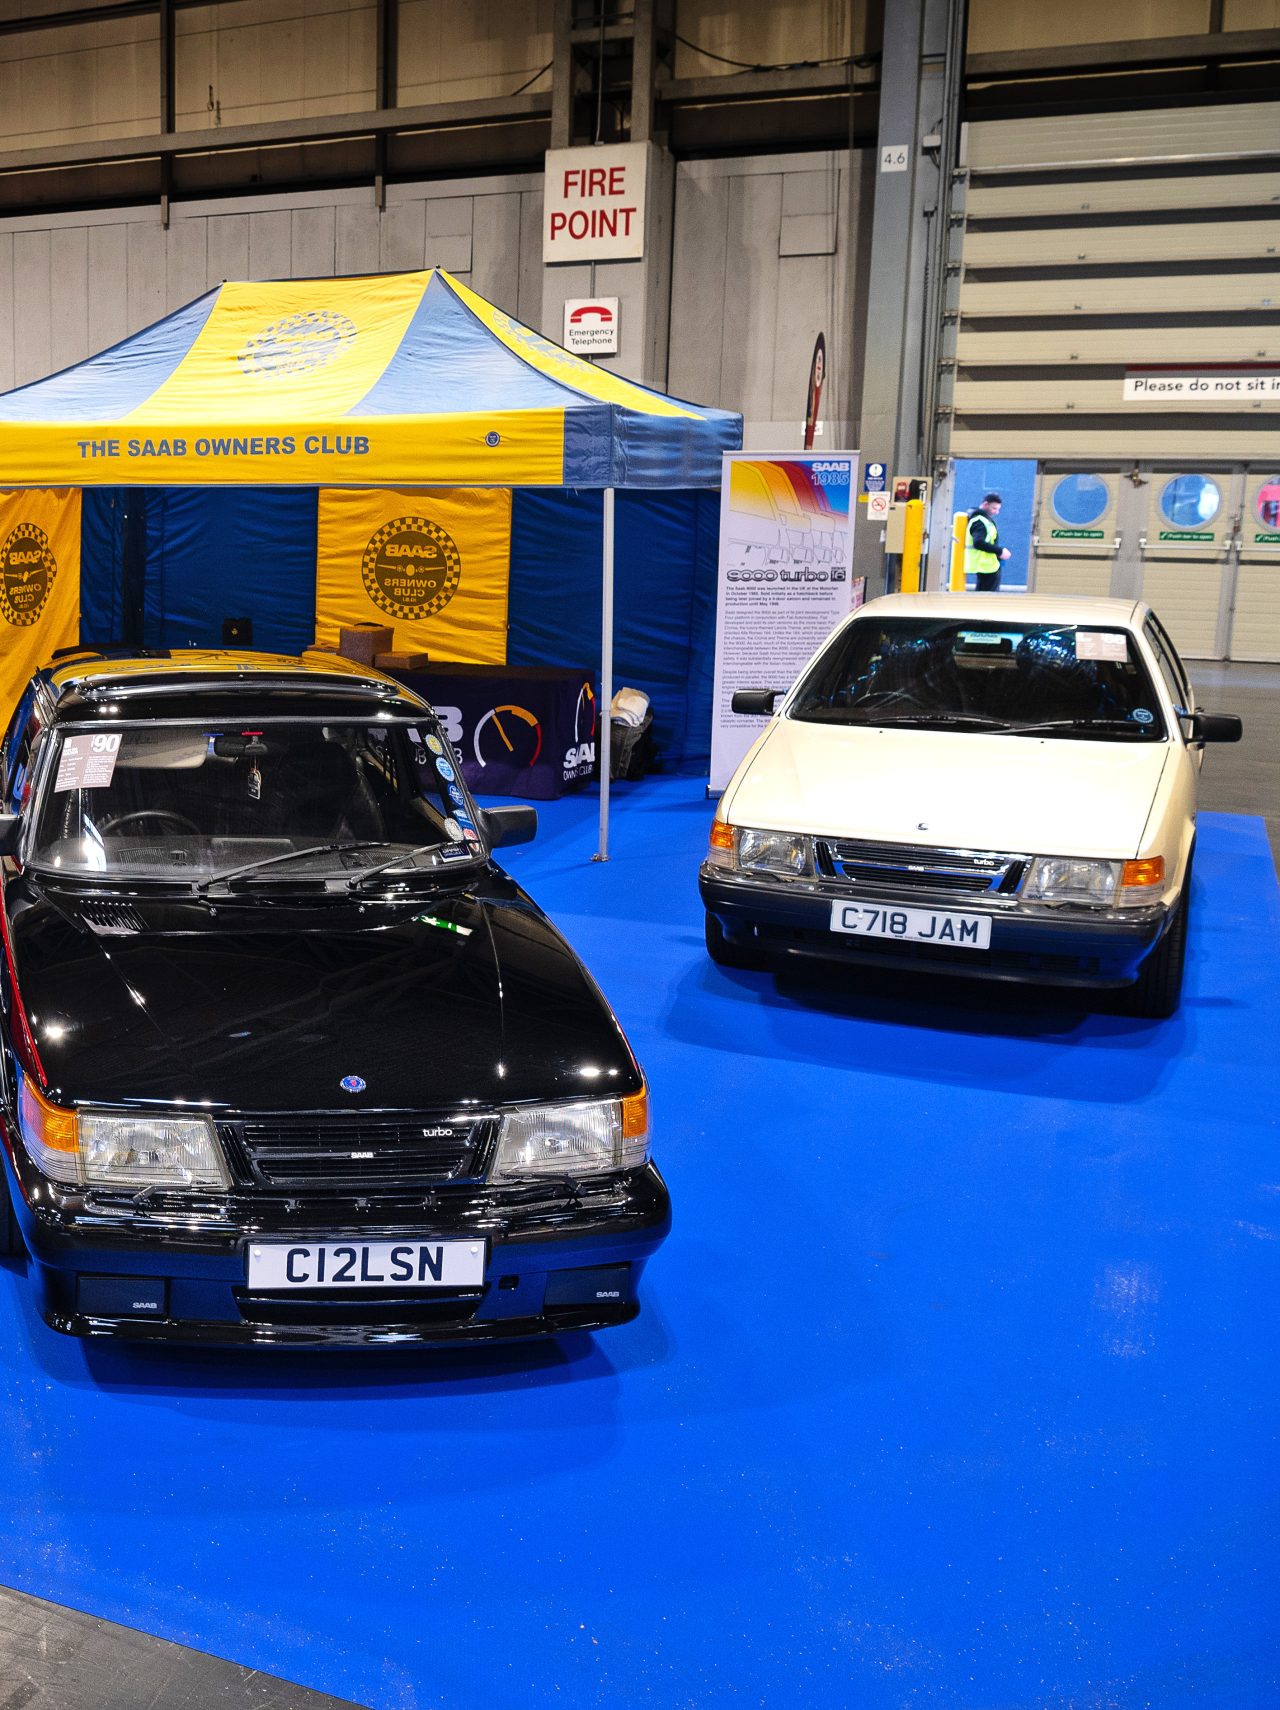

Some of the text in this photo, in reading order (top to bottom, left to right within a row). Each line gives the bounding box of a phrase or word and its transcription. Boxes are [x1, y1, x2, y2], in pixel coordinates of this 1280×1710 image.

[884, 153, 905, 164] 4.6
[563, 166, 625, 198] FIRE
[550, 207, 637, 240] POINT
[569, 328, 614, 337] Emergency
[571, 338, 612, 346] Telephone
[1134, 379, 1183, 392] Please
[1189, 378, 1209, 391] do
[1215, 380, 1241, 391] not
[1247, 379, 1266, 390] sit
[78, 435, 370, 459] THE SAAB OWNERS CLUB
[811, 462, 850, 472] SAAB
[811, 472, 850, 485] 1985
[726, 569, 778, 582] 9000
[780, 567, 829, 582] turbo
[973, 858, 994, 866] turbo
[841, 906, 979, 944] C718 JAM
[422, 1126, 453, 1137] turbo
